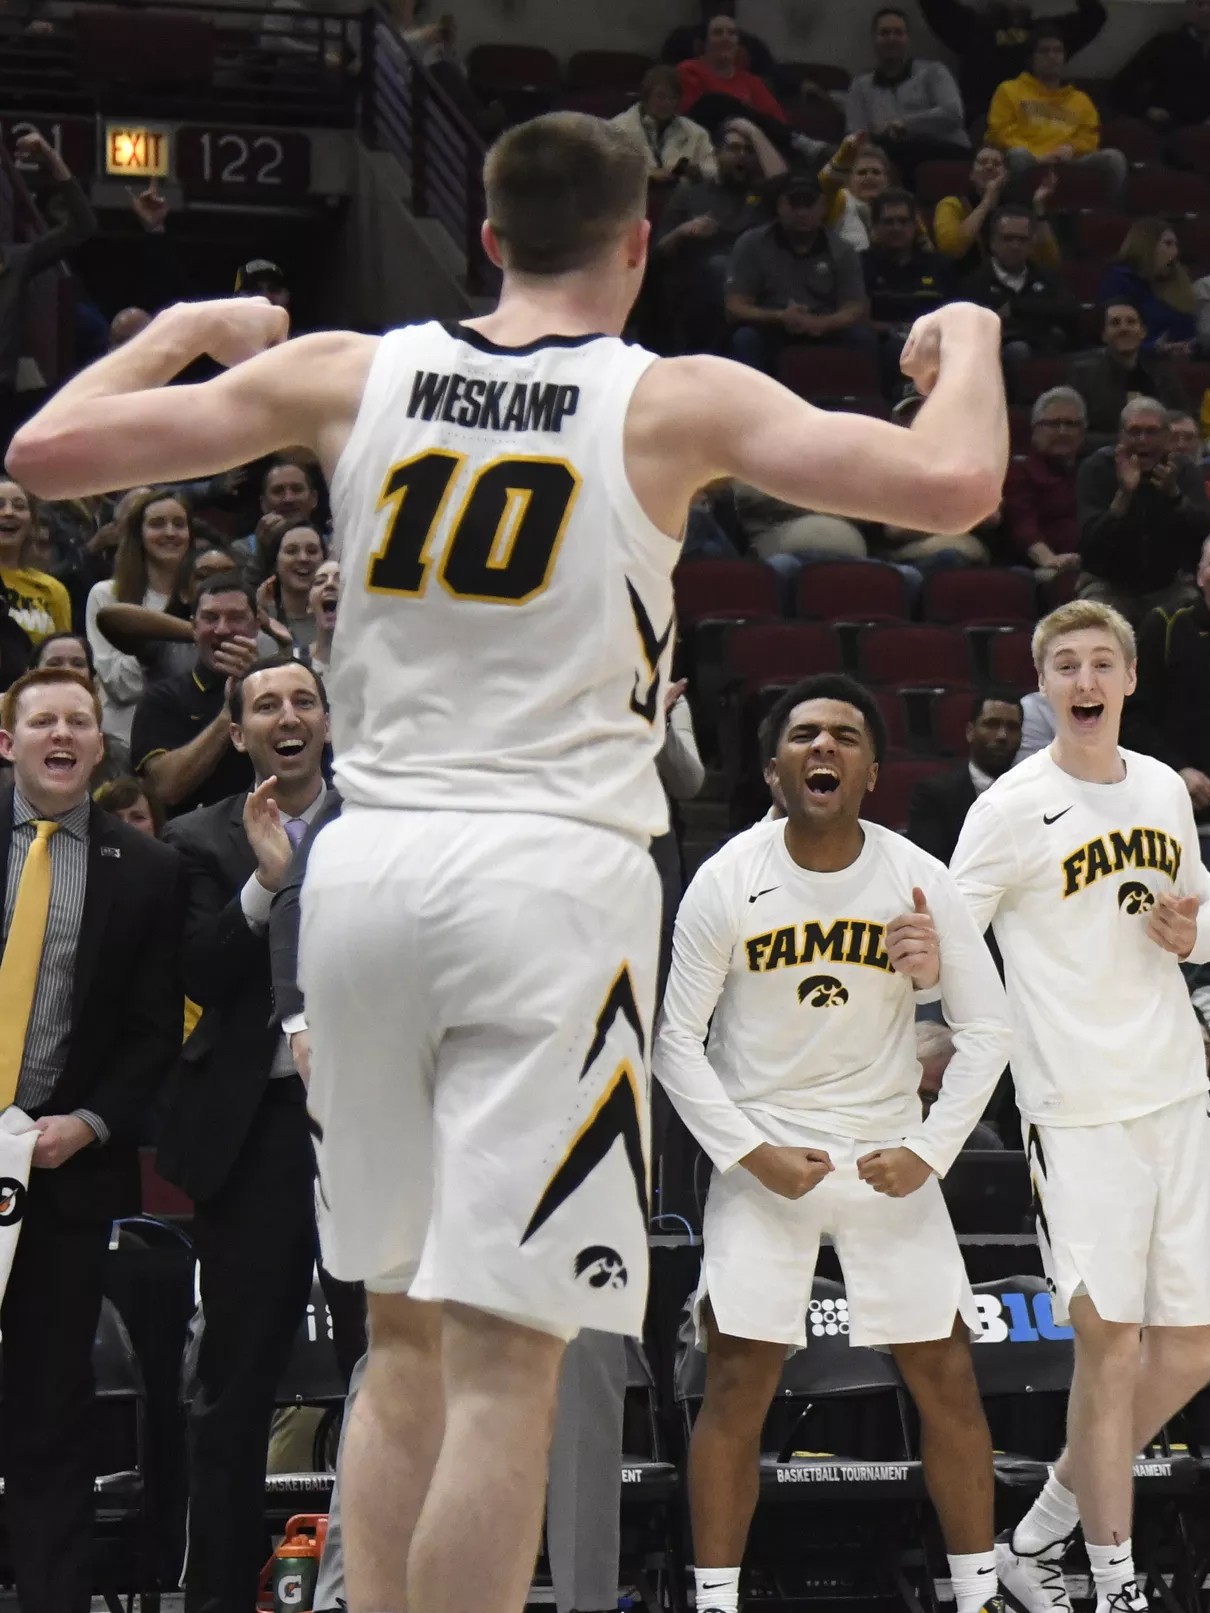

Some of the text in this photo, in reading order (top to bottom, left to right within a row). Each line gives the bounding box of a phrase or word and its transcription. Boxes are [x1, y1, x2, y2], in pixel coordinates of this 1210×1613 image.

[110, 131, 163, 168] EXIT
[201, 132, 284, 183] 122
[406, 370, 580, 432] WIESKAMP
[365, 447, 584, 607] 10
[1061, 826, 1182, 900] FAMILY
[744, 918, 897, 975] FAMIL
[777, 1466, 908, 1483] BASKETBALL TOURNAMENT
